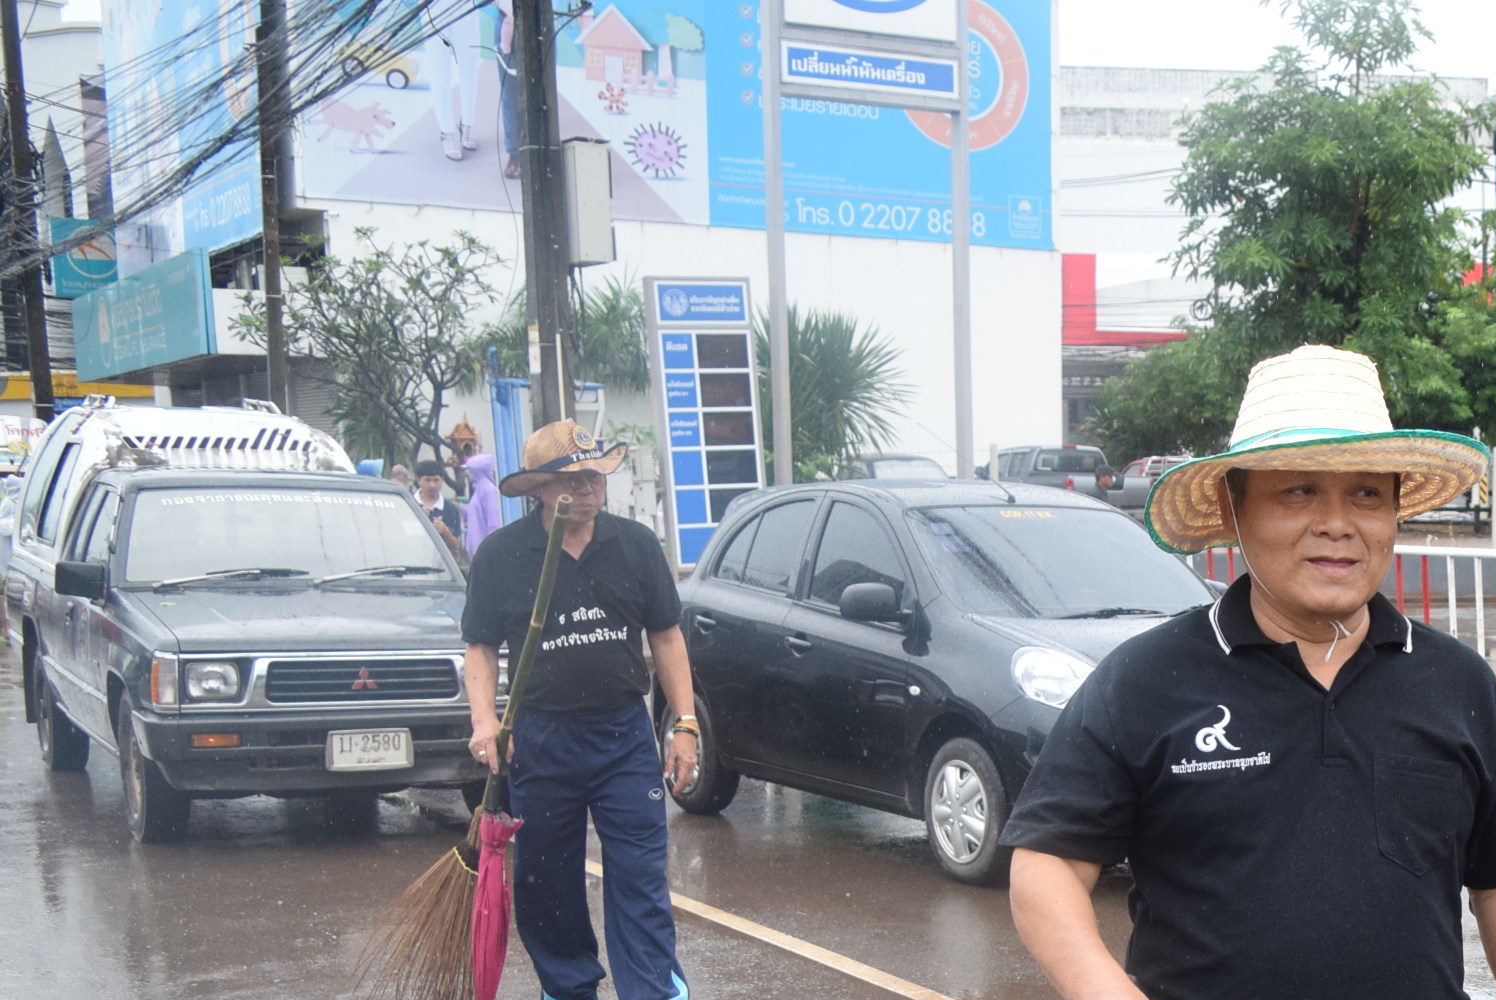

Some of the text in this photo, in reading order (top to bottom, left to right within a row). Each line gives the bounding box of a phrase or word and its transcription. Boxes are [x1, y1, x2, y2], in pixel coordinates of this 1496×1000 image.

[791, 50, 926, 85] เปลี่ยนน้ำมันเครื่อง
[796, 197, 835, 225] โทร.
[838, 200, 855, 227] 0
[860, 202, 922, 232] 2207
[927, 207, 987, 237] 888
[161, 489, 395, 509] กองสาธารณสุขและสิ่งแวดล้อม
[542, 626, 627, 651] ดวงใจไทยนิรันดร์
[1195, 704, 1241, 753] ๙
[1171, 751, 1271, 774] ขอเป็นข้ารองพระบาททุกชาติไป
